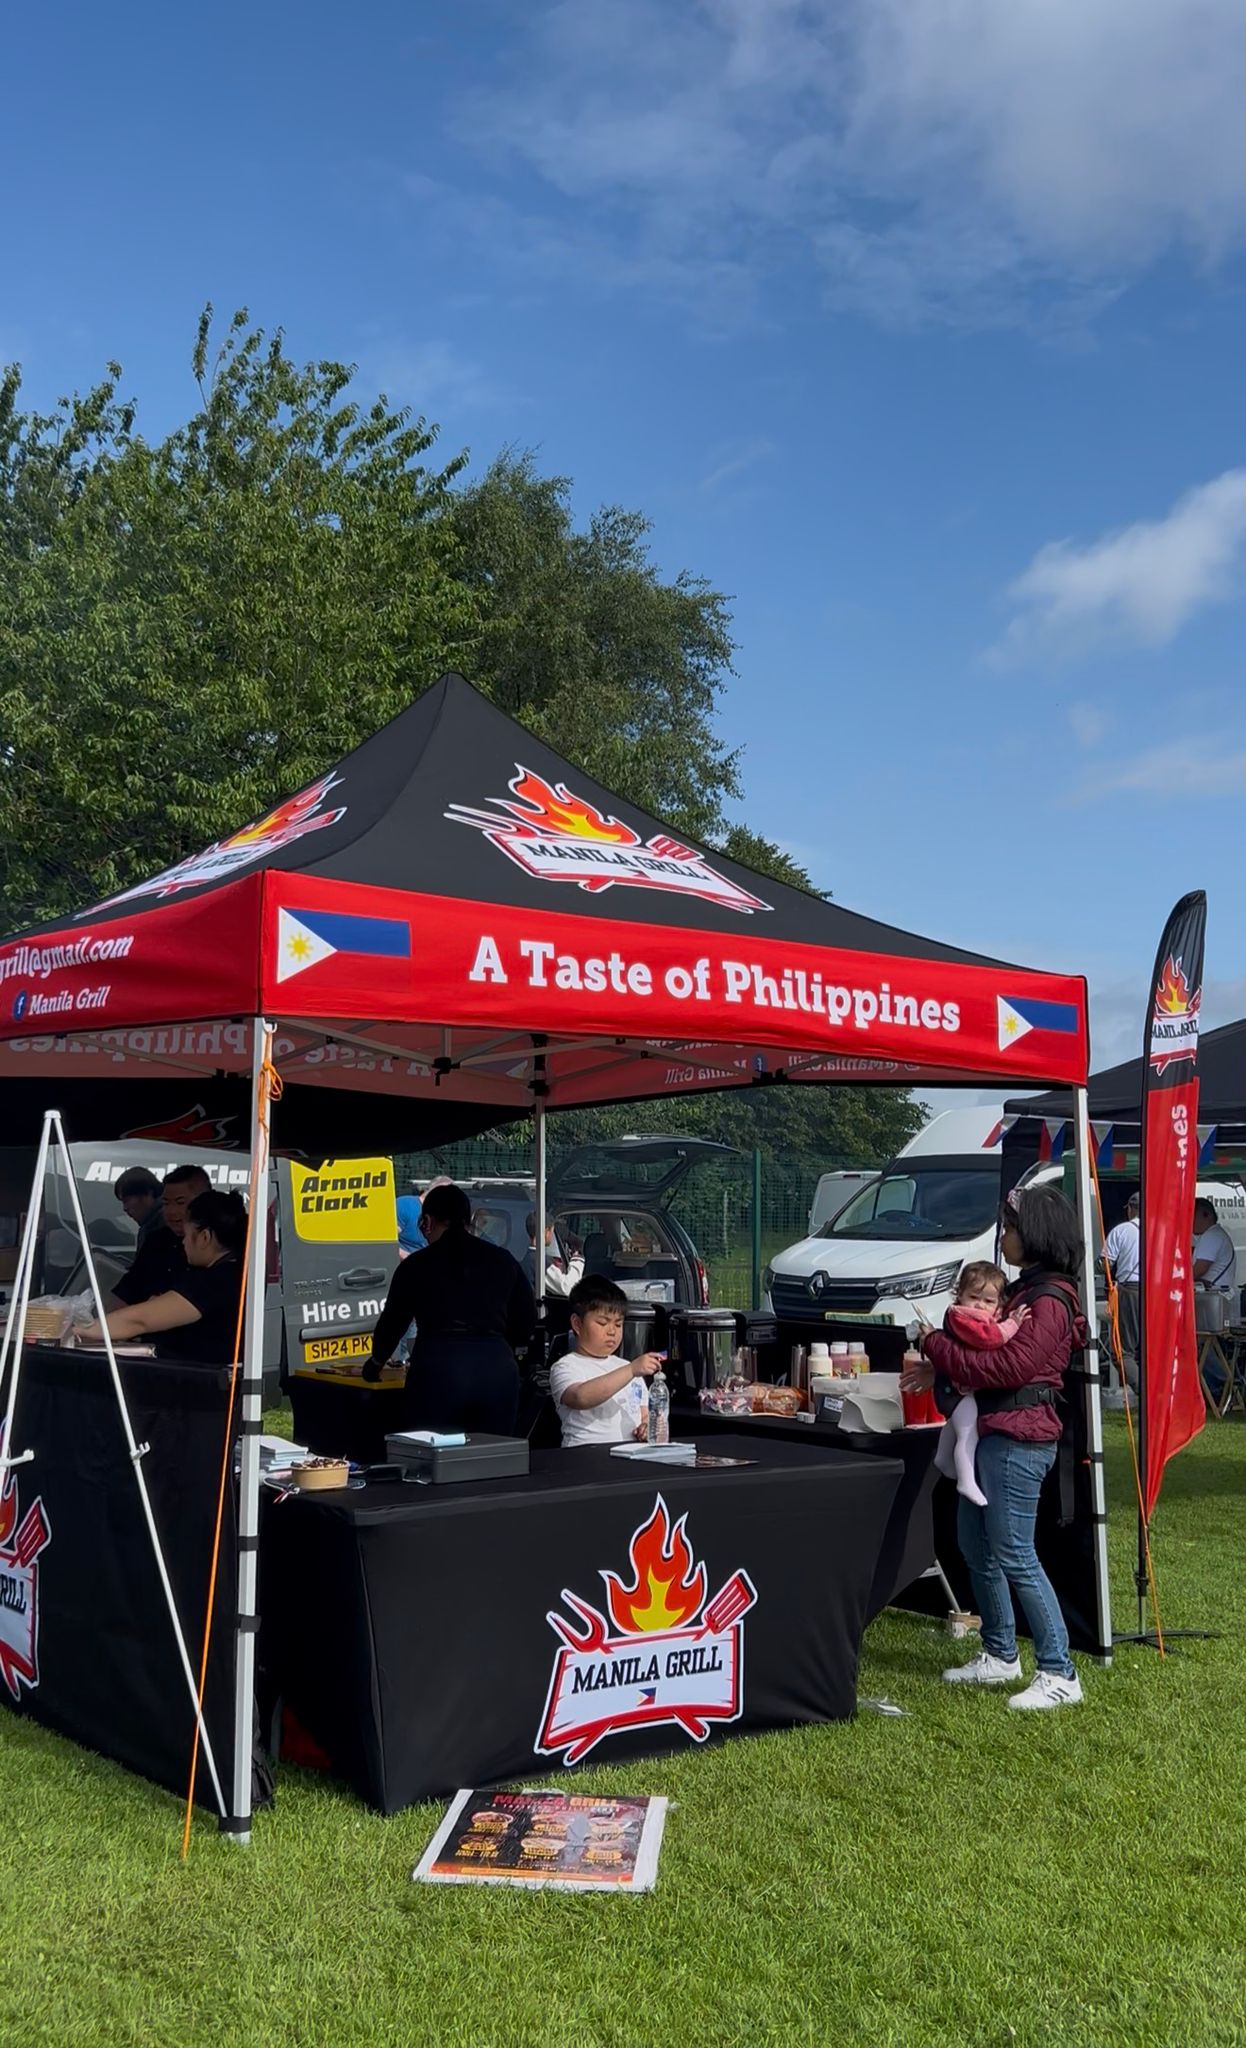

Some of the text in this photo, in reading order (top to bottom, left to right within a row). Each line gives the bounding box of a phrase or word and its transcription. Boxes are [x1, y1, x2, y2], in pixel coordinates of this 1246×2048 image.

[521, 843, 712, 881] MANILA GRILL
[469, 936, 961, 1032] A Taste of Philippines
[28, 990, 74, 1016] Manila
[75, 985, 111, 1010] Grill
[301, 1171, 387, 1193] Arnold
[301, 1192, 368, 1214] Clark
[302, 1301, 351, 1324] Hire
[311, 1335, 374, 1359] SH24 PK
[571, 1645, 722, 1694] MANILA GRILL
